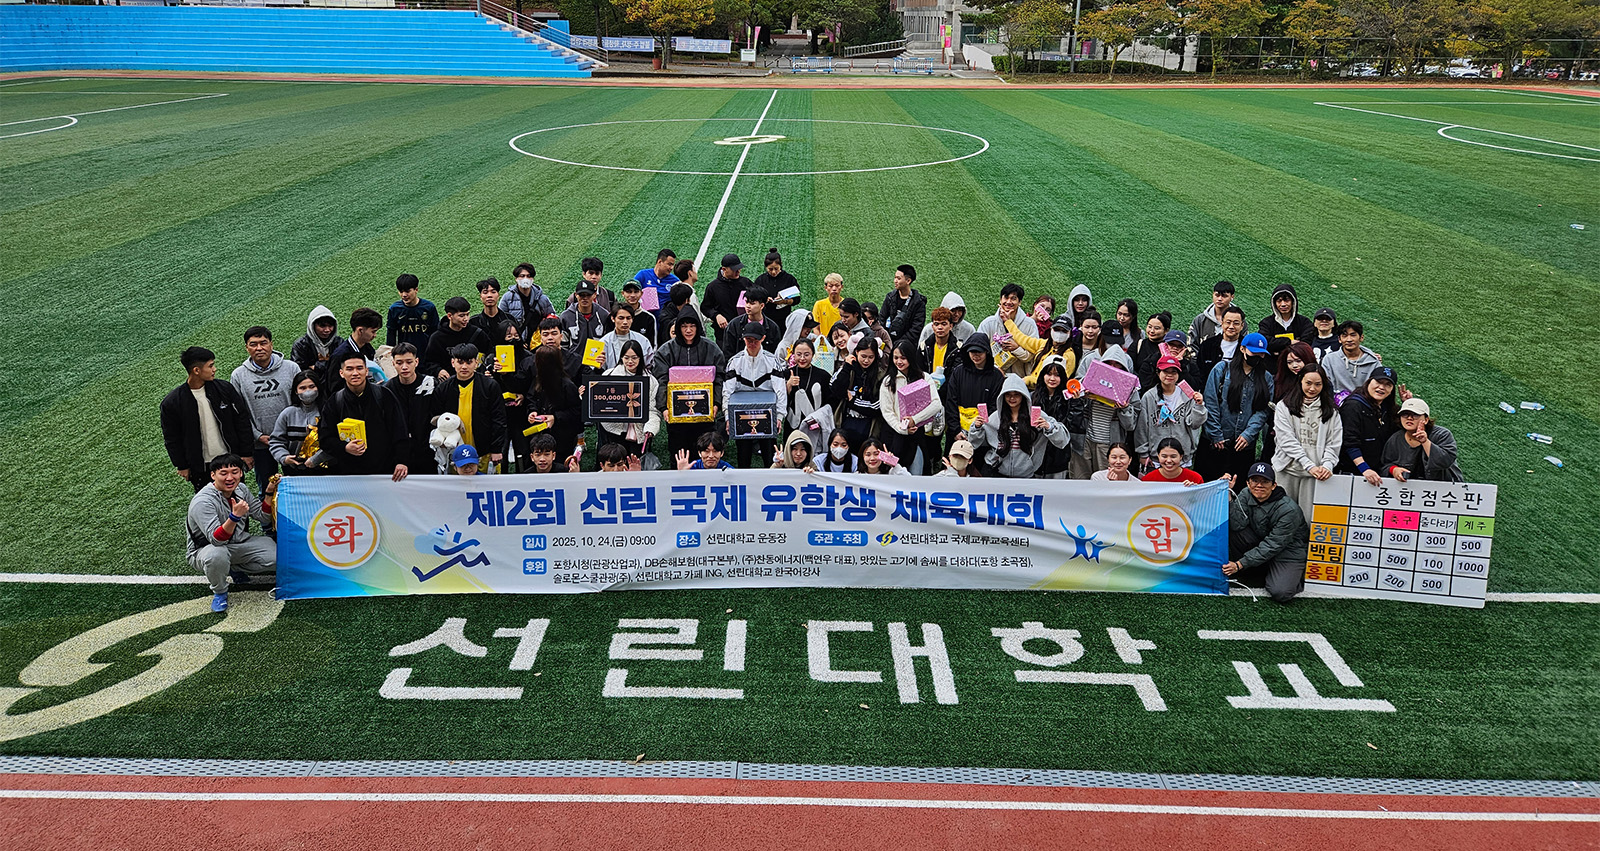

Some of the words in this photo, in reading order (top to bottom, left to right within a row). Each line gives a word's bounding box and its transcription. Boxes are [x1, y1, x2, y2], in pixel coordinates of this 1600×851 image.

[401, 324, 427, 332] KAFD
[466, 488, 567, 526] 제2회
[580, 486, 657, 525] 선린
[671, 484, 747, 523] 국제
[761, 484, 877, 522] 유학생
[890, 490, 1045, 530] 체육대회
[323, 515, 363, 554] 화
[525, 537, 544, 549] 일시
[552, 536, 579, 548] 2025.
[581, 537, 596, 548] 10.
[630, 535, 656, 546] 09:00
[679, 535, 699, 546] 장소
[706, 533, 756, 545] 선린대학교
[757, 533, 787, 544] 운동장
[900, 533, 949, 545] 선린대학교
[950, 533, 1030, 547] 국제교류교육센터
[1140, 516, 1179, 554] 합
[1312, 525, 1343, 543] 청팀
[1352, 531, 1373, 541] 200
[1389, 533, 1410, 544] 300
[1426, 536, 1446, 546] 300
[1461, 541, 1481, 551] 500
[525, 561, 544, 573] 후원
[553, 558, 643, 571] 포항시청(관광산업과),
[644, 554, 740, 569] DB손해보험(대구본부),
[834, 554, 858, 566] 대표),
[860, 555, 888, 566] 맛있는
[889, 556, 918, 567] 고기에
[920, 556, 948, 567] 솜씨를
[950, 556, 998, 567] 더하다(포항
[1001, 556, 1034, 568] 초곡점),
[1310, 544, 1343, 563] 백팀
[1351, 551, 1372, 560] 300
[1386, 555, 1407, 566] 500
[1423, 559, 1443, 570] 100
[1458, 562, 1484, 573] 1000
[553, 573, 633, 584] 솔로몬스쿨관광(주),
[635, 570, 682, 582] 선린대학교
[684, 568, 703, 580] 카페
[705, 568, 725, 579] ING,
[727, 566, 772, 578] 선린대학교
[775, 566, 821, 578] 한국어강사
[1306, 563, 1339, 582] 홍팀
[1349, 572, 1369, 583] 200
[1385, 574, 1405, 589] 200
[1422, 579, 1442, 590] 500
[379, 617, 1396, 713] 선린대학교
